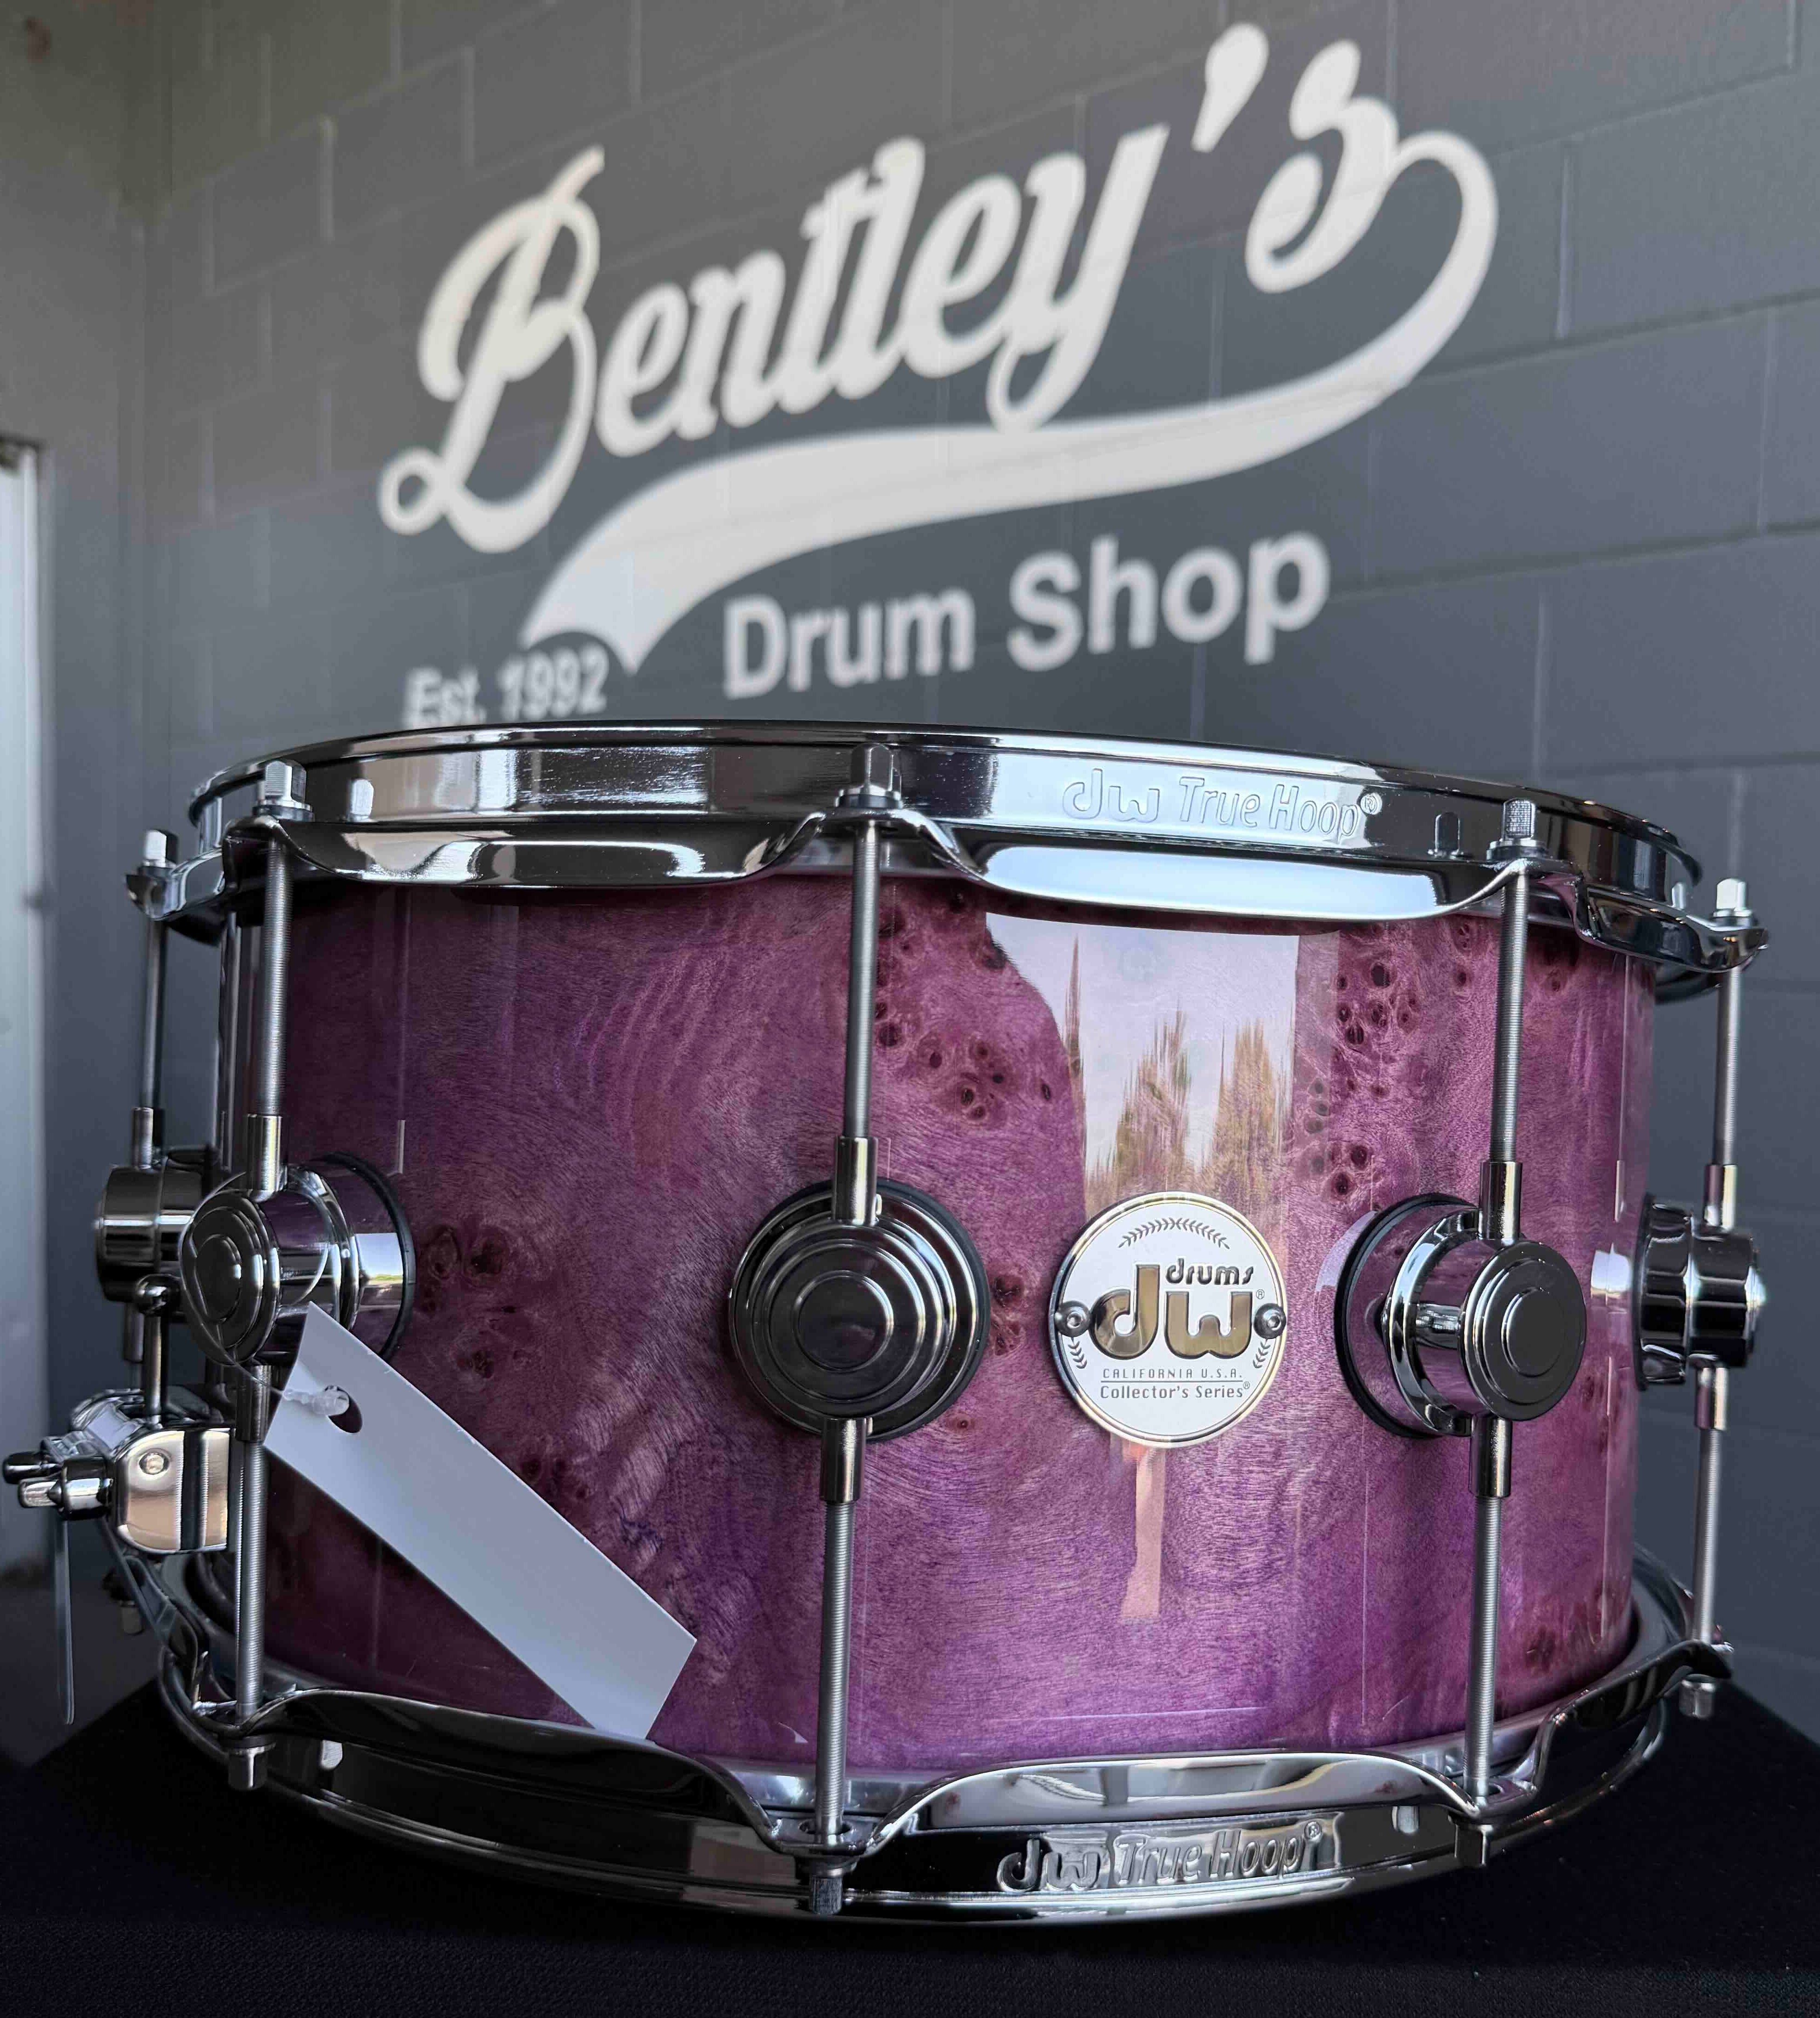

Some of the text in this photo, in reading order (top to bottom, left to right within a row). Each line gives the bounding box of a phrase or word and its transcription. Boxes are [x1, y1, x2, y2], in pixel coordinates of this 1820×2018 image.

[379, 22, 1499, 553] Bentley's
[723, 531, 1331, 698] Drum Shop
[402, 641, 611, 729] Est. 1992
[1062, 767, 1161, 824] dw
[1178, 776, 1261, 828] True
[1165, 1257, 1254, 1286] drums
[1100, 1385, 1189, 1399] Collector's
[1103, 1368, 1243, 1379] CALIFORNIA U.S.A.
[996, 1837, 1101, 1893] dw
[1113, 1834, 1203, 1885] True
